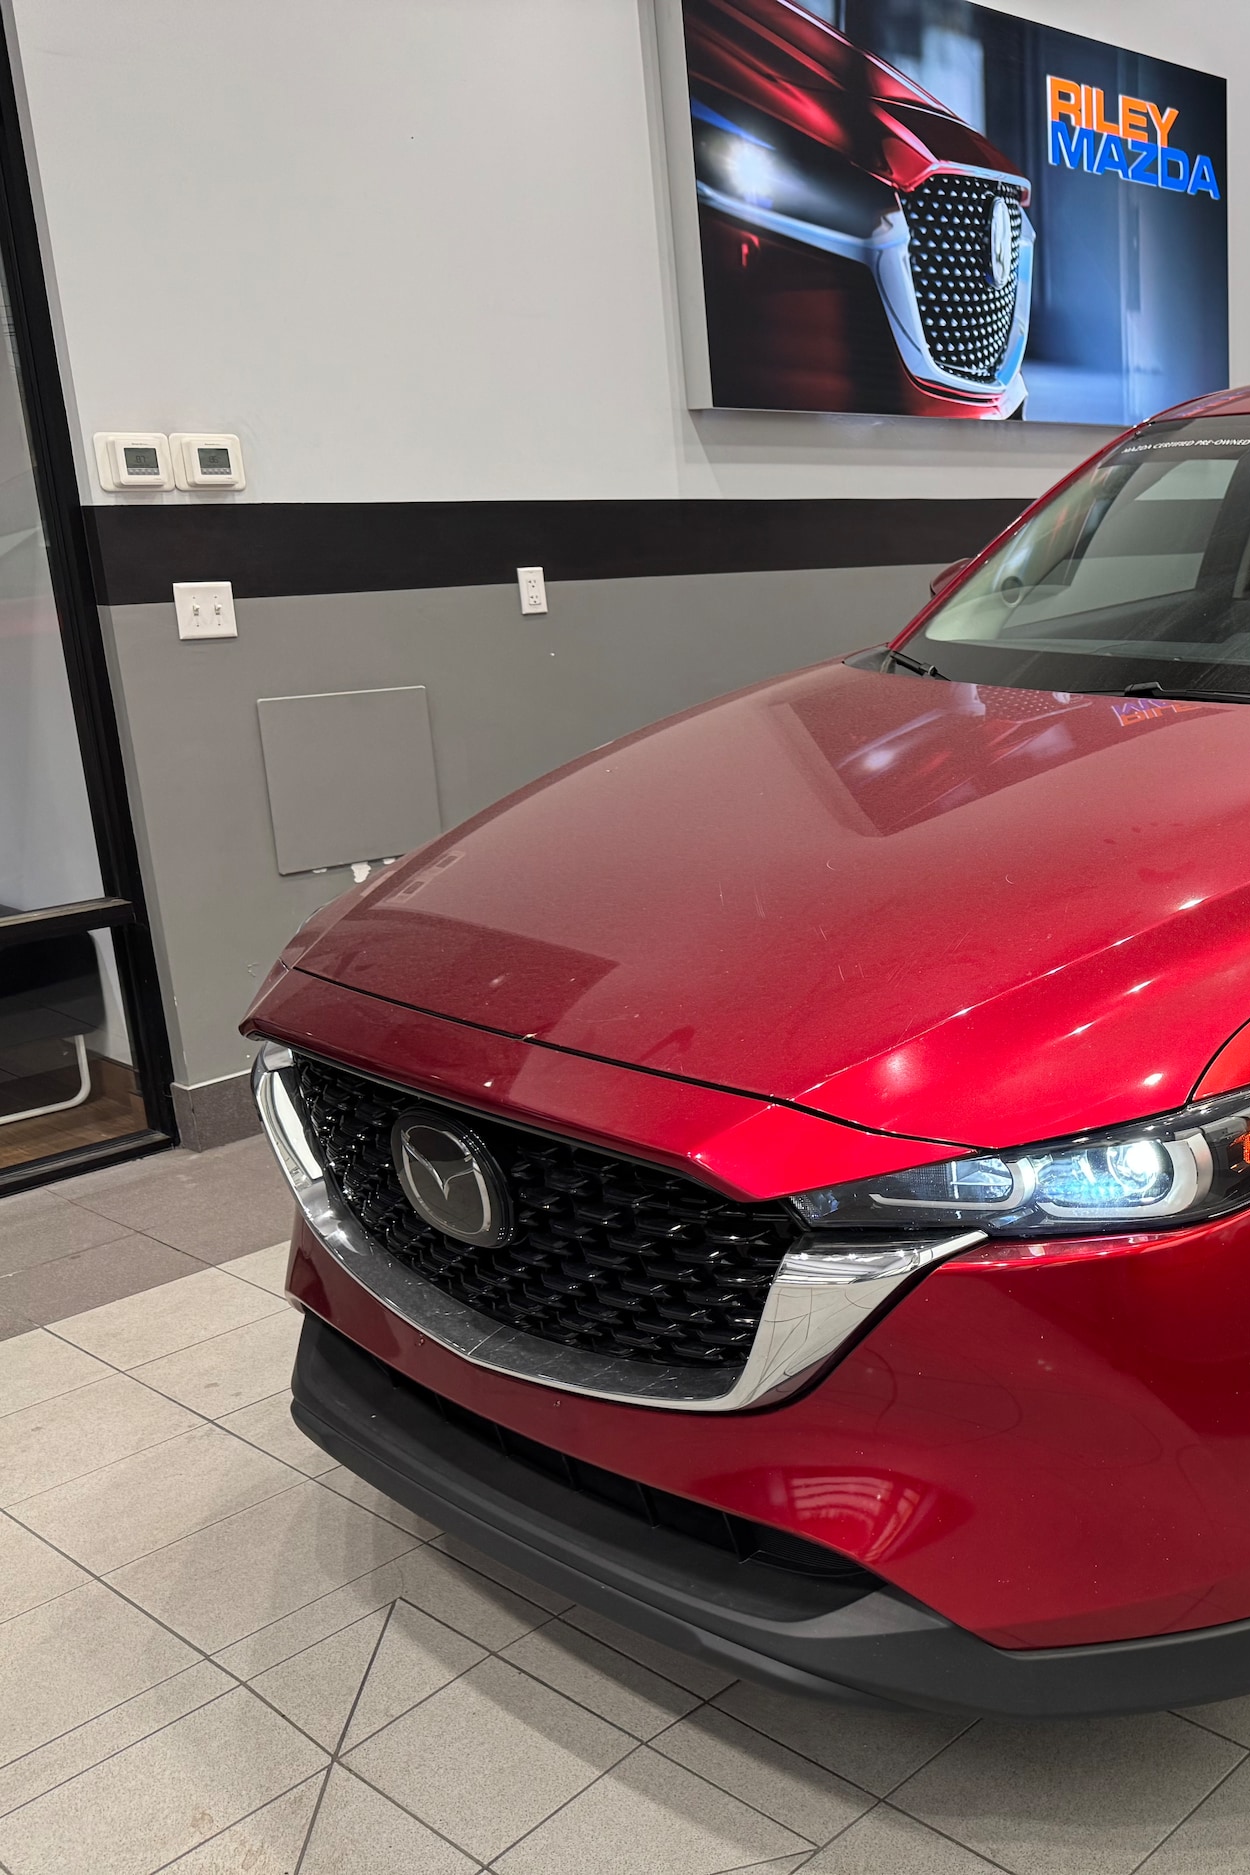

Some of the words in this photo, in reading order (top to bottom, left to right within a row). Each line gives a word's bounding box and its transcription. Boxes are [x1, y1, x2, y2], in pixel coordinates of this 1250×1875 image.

[1046, 74, 1180, 148] RILEY
[1048, 120, 1221, 200] MAZDA
[1153, 440, 1195, 449] CERTIFIED
